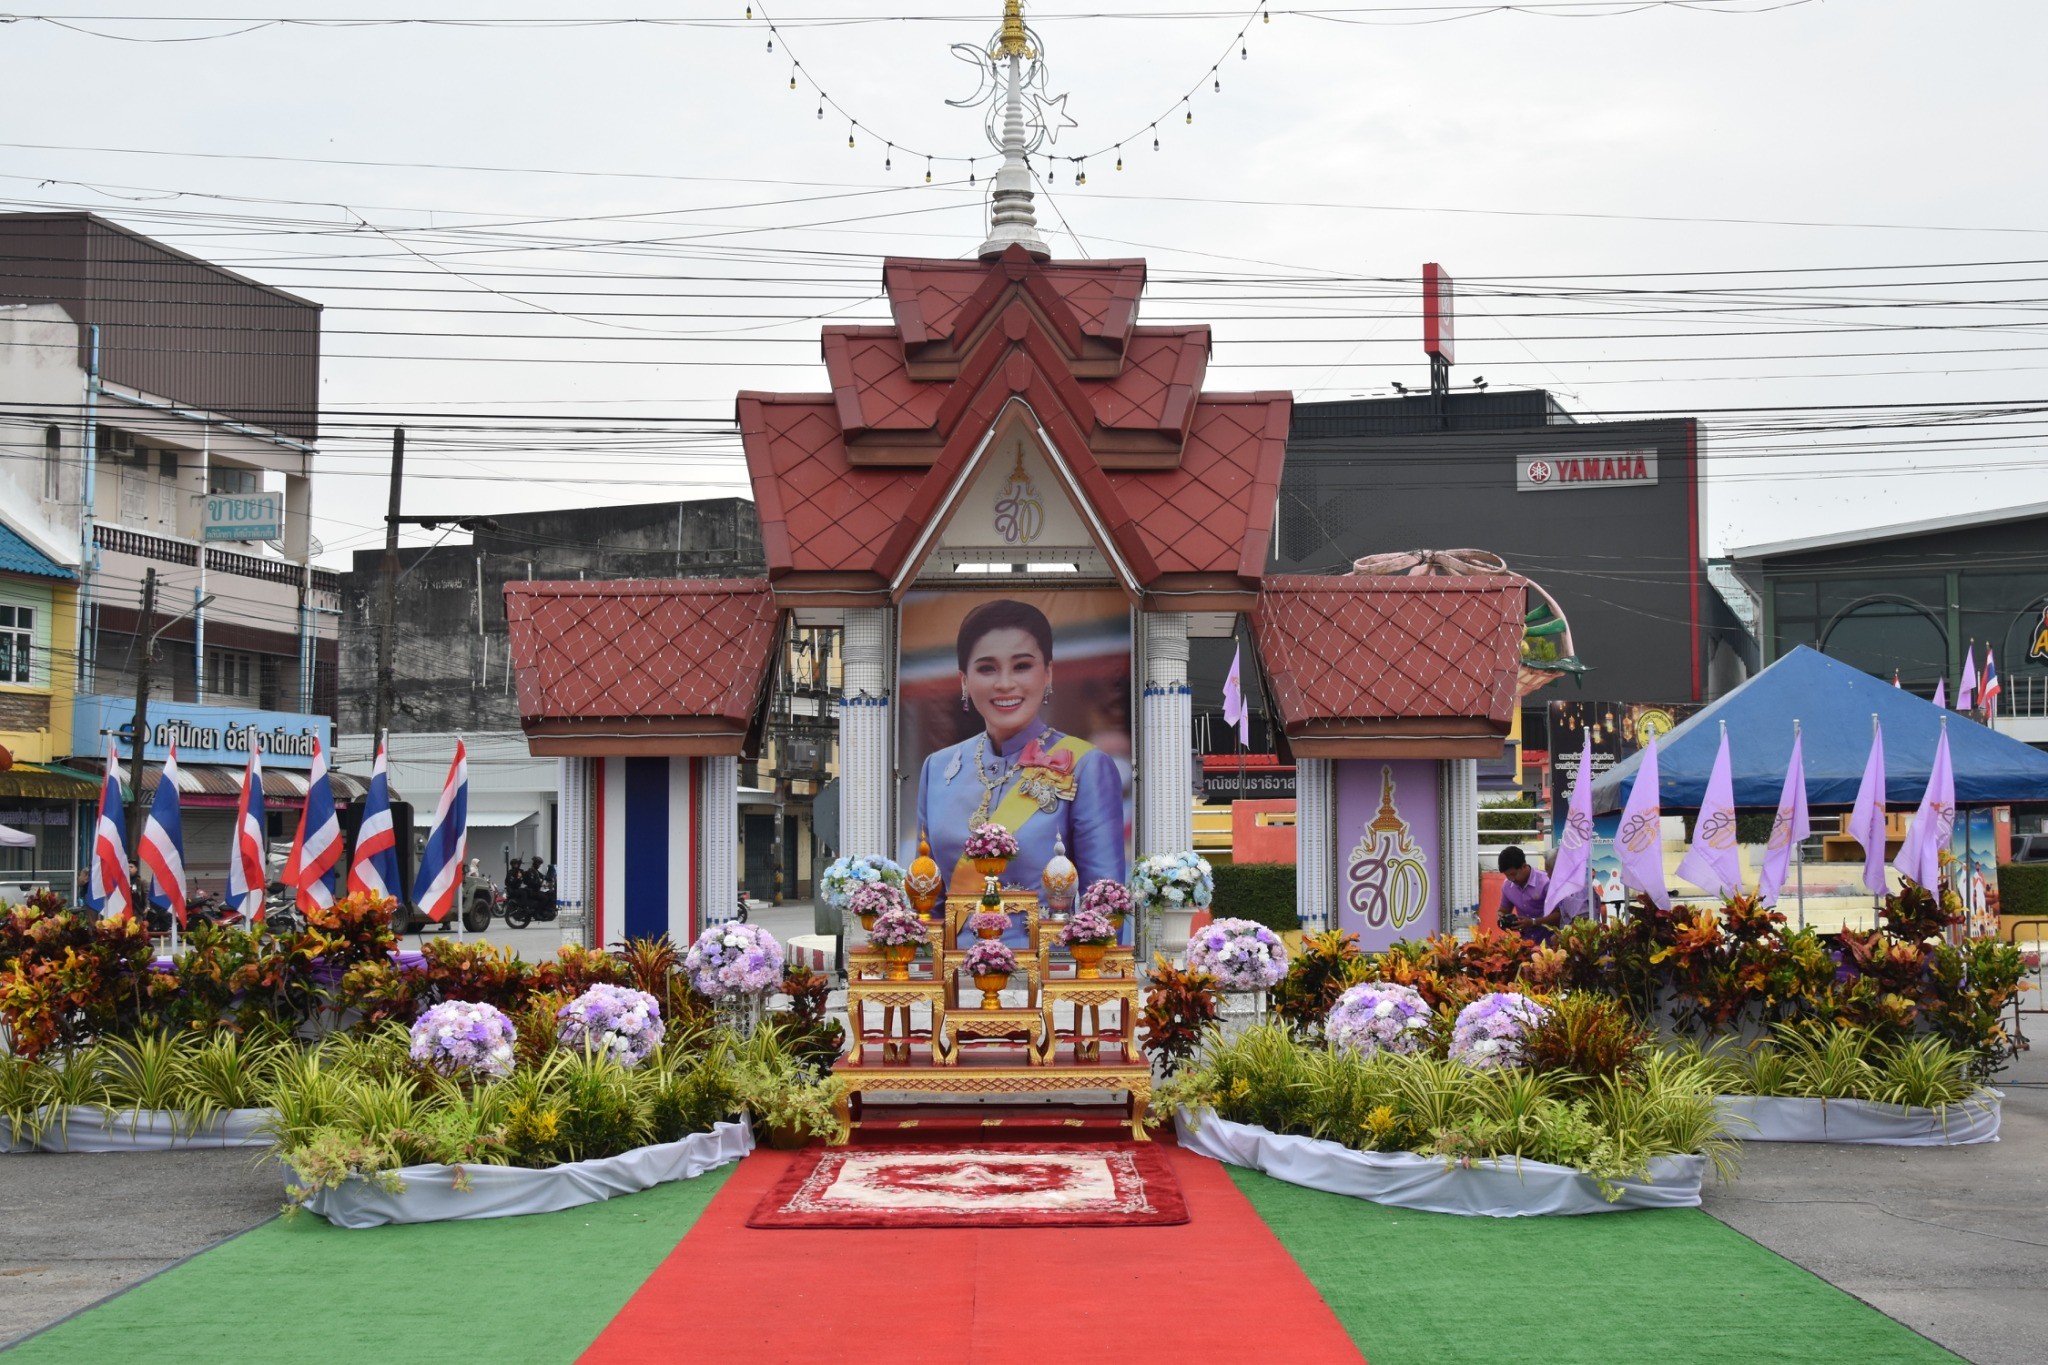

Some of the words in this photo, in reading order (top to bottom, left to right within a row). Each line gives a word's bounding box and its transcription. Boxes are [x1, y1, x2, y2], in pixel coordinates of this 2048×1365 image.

[1555, 455, 1648, 482] YAMAHA
[207, 497, 274, 522] ขายยา
[156, 719, 220, 750] คลินิกยา
